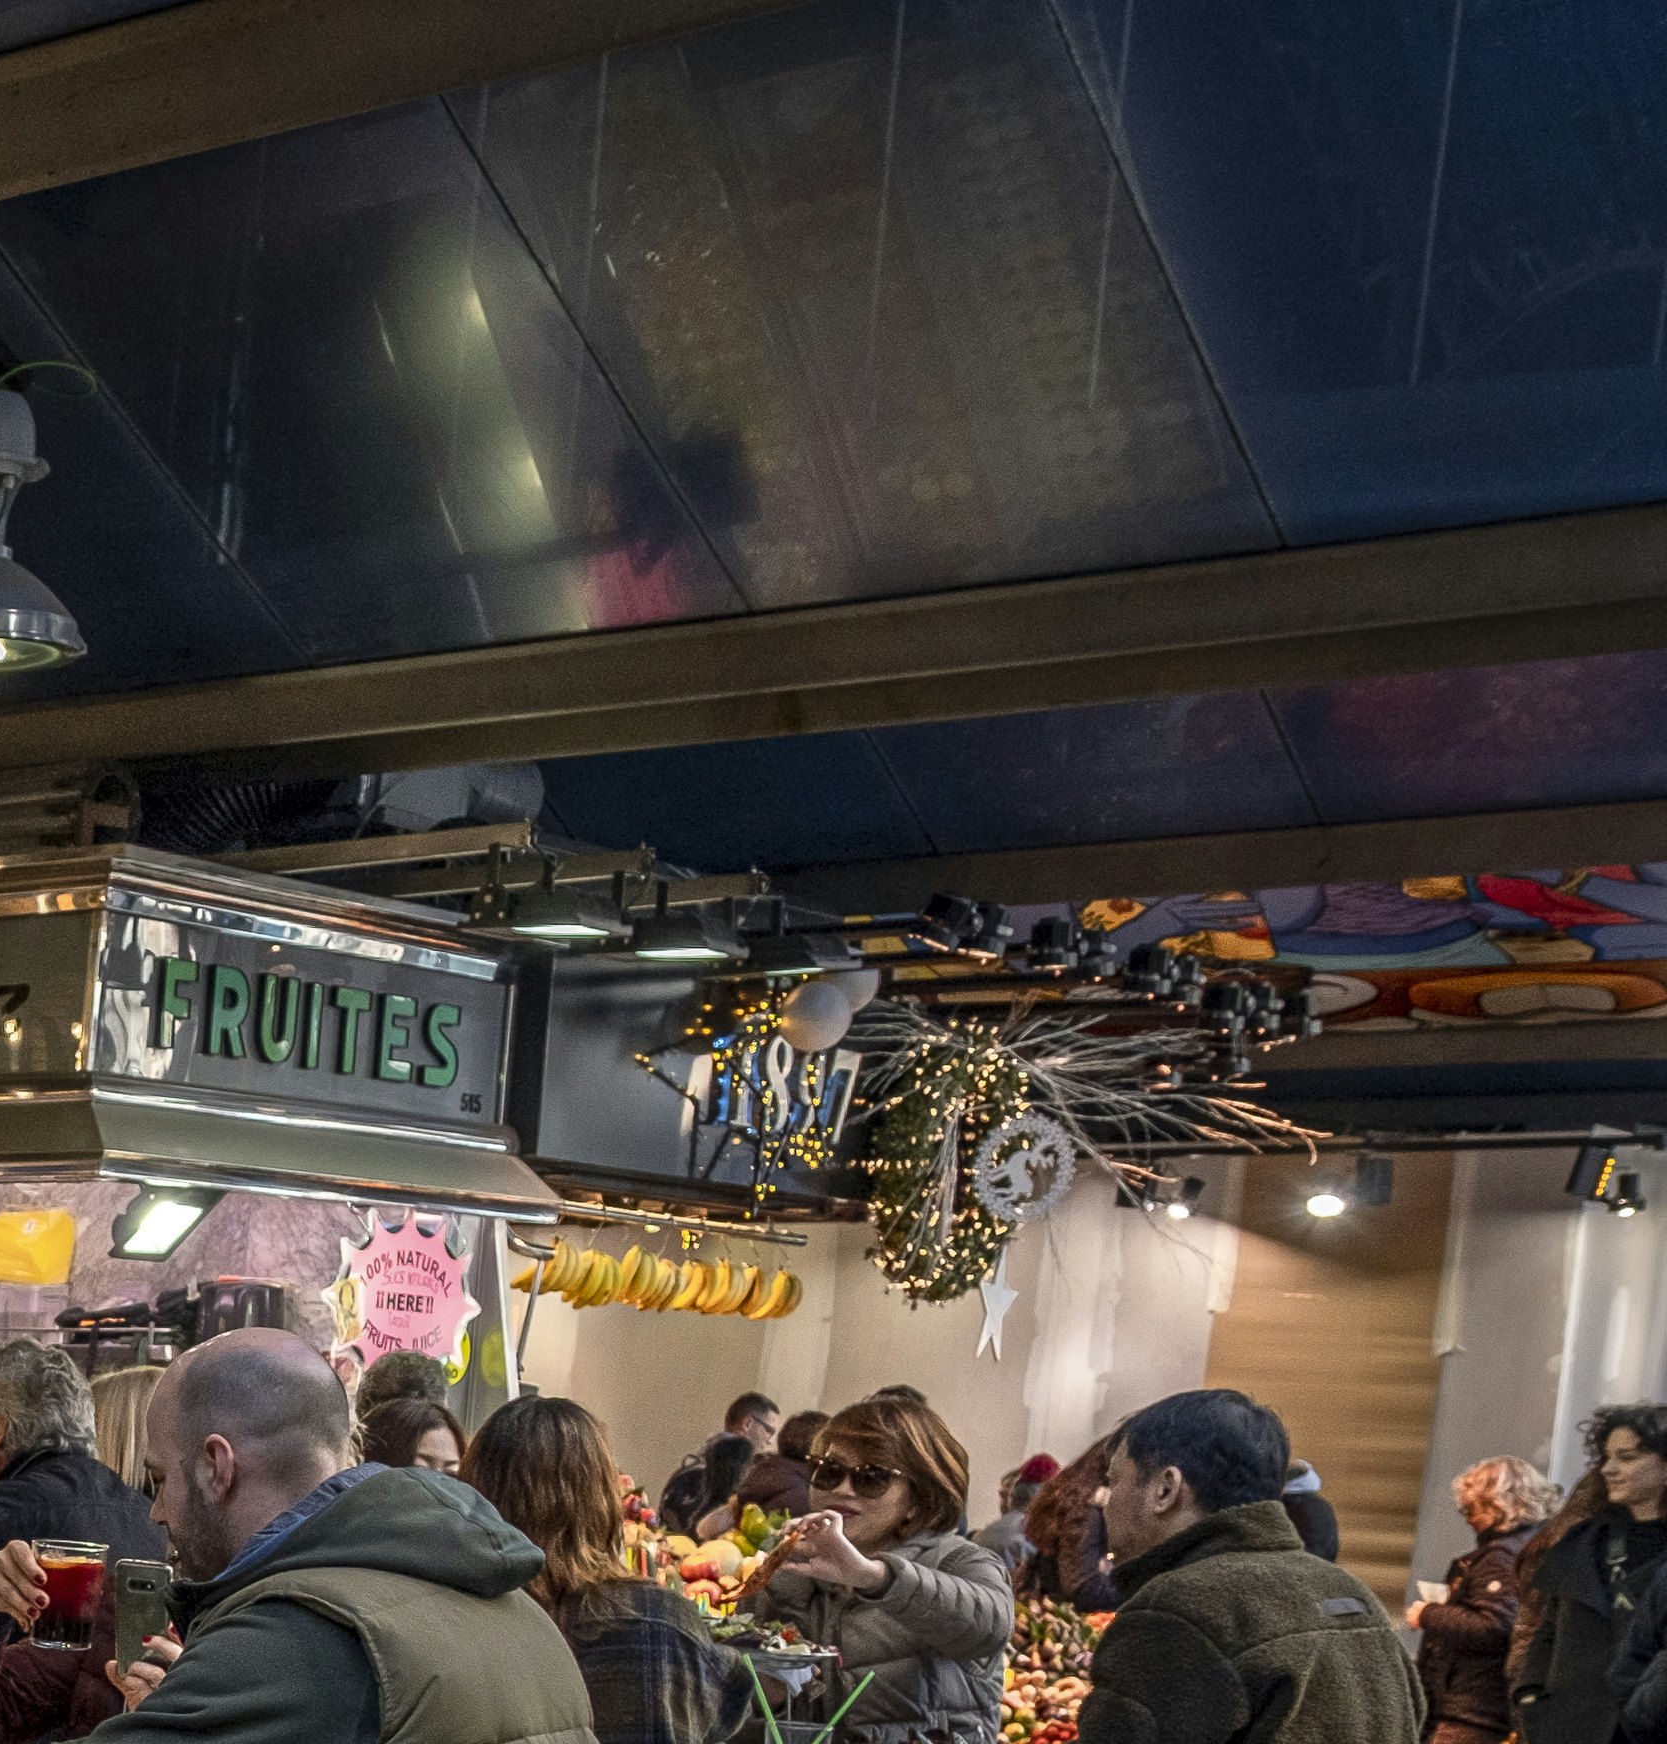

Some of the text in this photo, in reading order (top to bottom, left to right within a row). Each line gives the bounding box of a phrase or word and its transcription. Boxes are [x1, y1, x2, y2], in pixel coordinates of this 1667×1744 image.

[157, 956, 460, 1087] FRUITES
[460, 1092, 483, 1114] 515
[397, 1250, 454, 1298] NATURAL
